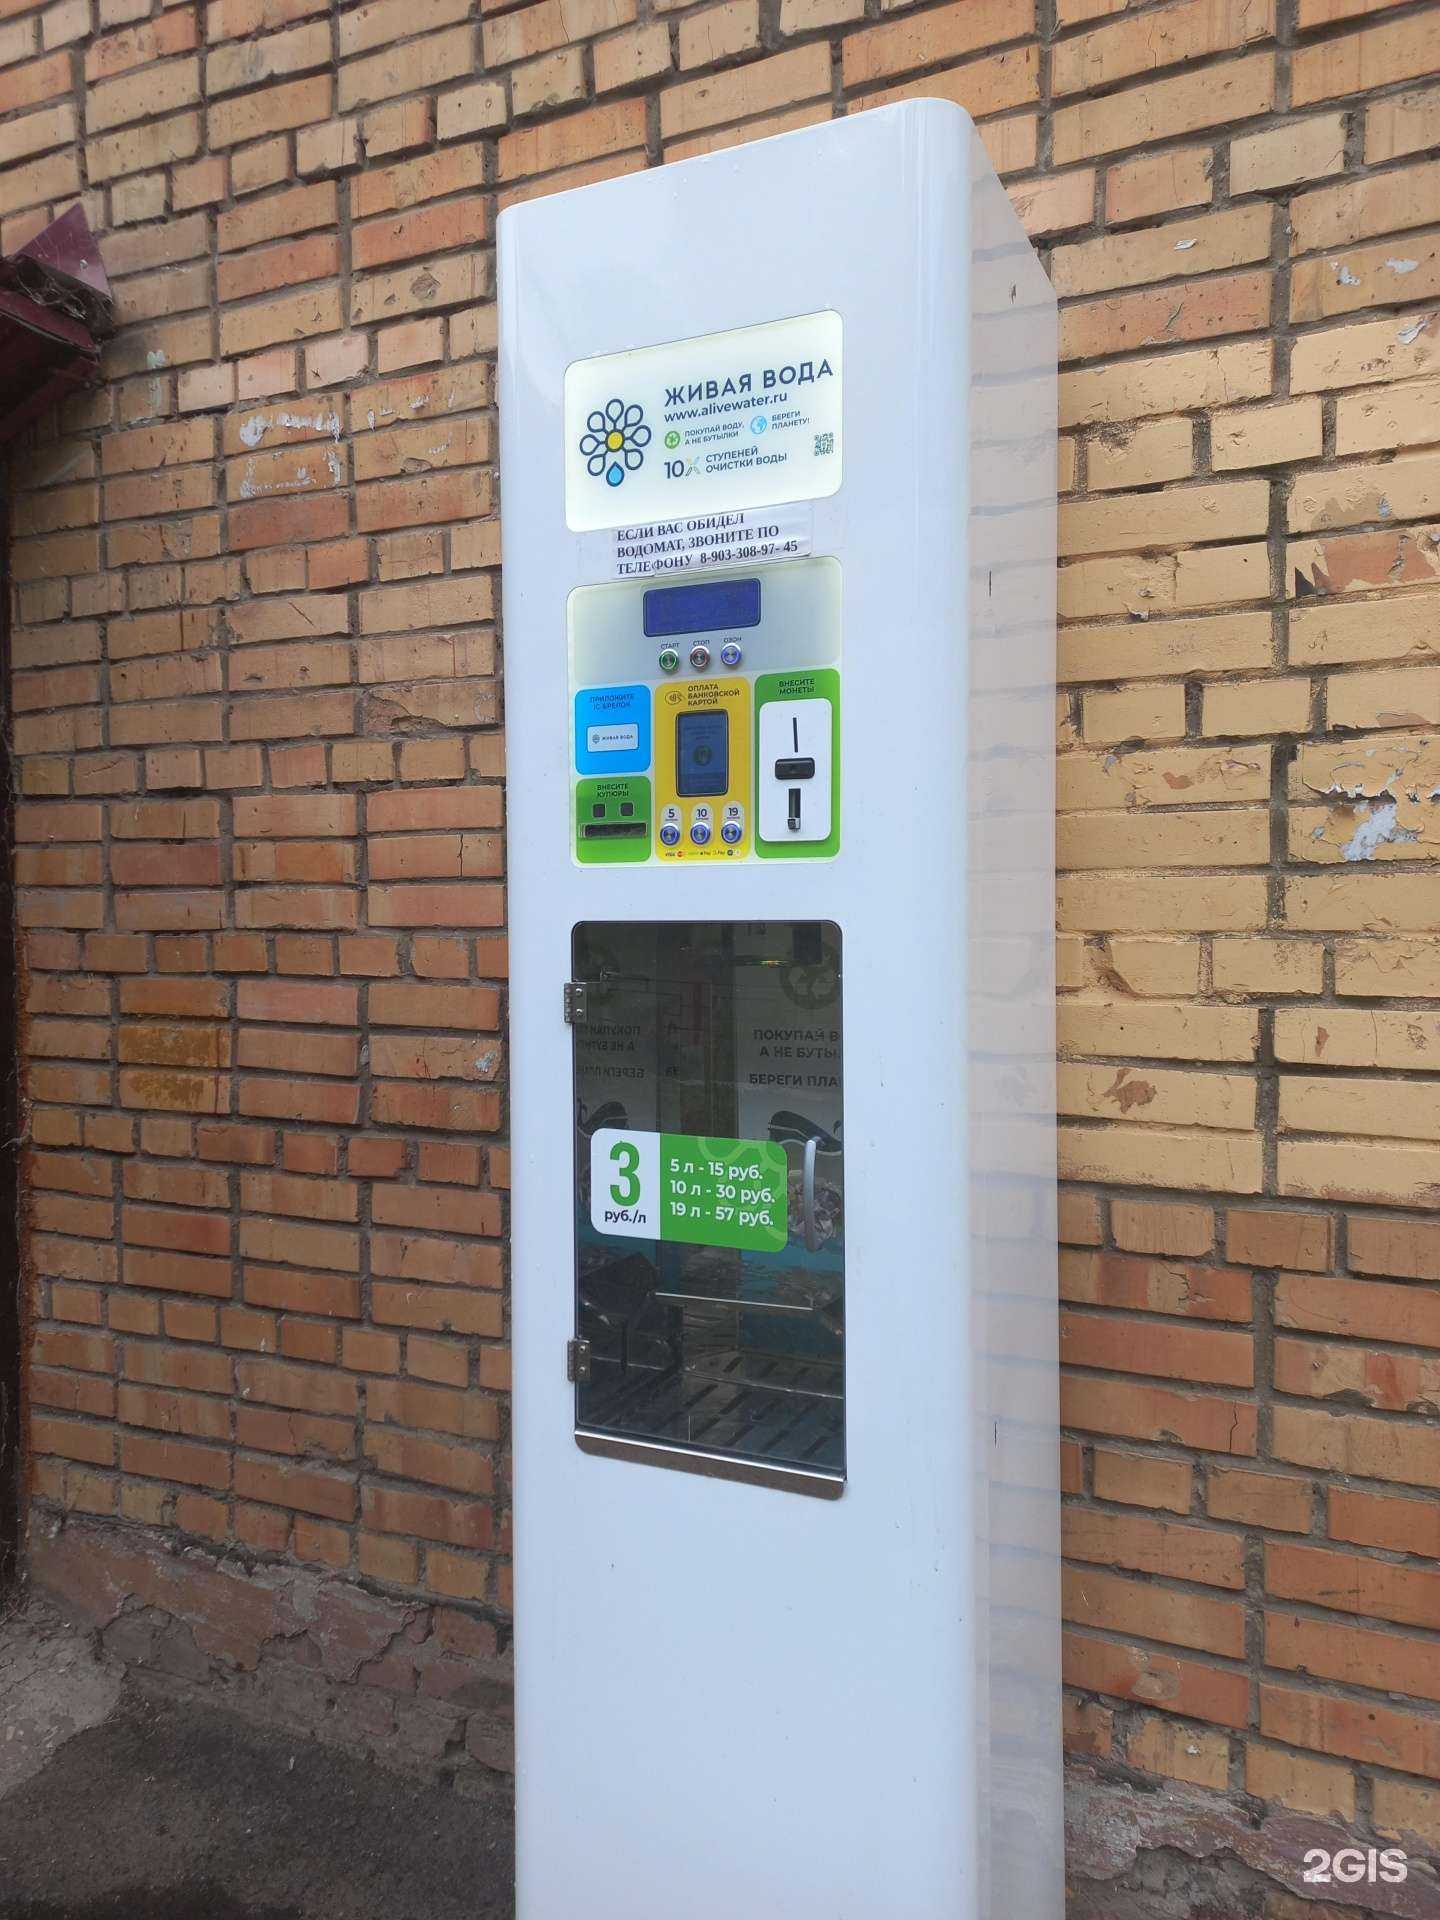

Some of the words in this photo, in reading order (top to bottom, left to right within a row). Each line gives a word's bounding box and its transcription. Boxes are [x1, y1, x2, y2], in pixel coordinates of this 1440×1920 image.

[664, 373, 752, 407] ЖИВАЯ
[763, 359, 833, 388] ВОДА
[664, 392, 787, 423] www.alivewater.ru
[772, 411, 800, 422] БЕРЕГИ
[684, 424, 720, 436] ПОКУПАЙ
[722, 421, 744, 432] ВОДУ,
[772, 417, 810, 430] ПЛАНЕТУ!
[691, 437, 701, 445] НЕ
[703, 432, 738, 444] БУТЫЛКИ
[706, 446, 758, 463] СТУПЕНЕЙ
[706, 458, 753, 473] ОЧИСТКИ
[756, 453, 787, 467] ВОДЫ
[617, 527, 654, 542] ЕСЛИ
[657, 522, 683, 536] ВАС
[687, 513, 744, 535] ОБИДЕЛ
[617, 539, 685, 558] ВОДОМАТ,
[688, 529, 753, 548] ЗВОНИТЕ
[758, 525, 779, 538] ПО
[617, 554, 693, 575] ТЕЛЕФОНУ
[693, 639, 710, 647] СТОП
[688, 684, 718, 692] ОПЛАТА
[779, 679, 814, 688] ВНЕСИТЕ
[688, 690, 740, 699] БАНКОВСКОЙ
[779, 686, 814, 695] МОНЕТЫ
[688, 697, 717, 706] КАРТОЙ
[597, 783, 628, 791] ВНЕСИТЕ
[597, 789, 628, 798] КУПЮРЫ
[668, 808, 674, 818] 5
[697, 808, 708, 818] 10
[728, 807, 738, 816] 19
[753, 1028, 825, 1041] ПОКУПАЙ
[760, 1047, 769, 1057] А
[773, 1047, 793, 1058] НЕ
[797, 1048, 838, 1058] БУТЫ
[750, 1073, 801, 1086] БЕРЕГИ
[609, 1141, 641, 1206] 3
[670, 1159, 679, 1172] 5
[684, 1163, 693, 1173] л
[708, 1162, 724, 1176] 15
[728, 1164, 763, 1182] руб.
[670, 1180, 686, 1194] 10
[690, 1184, 700, 1195] л
[715, 1186, 736, 1198] 30
[740, 1188, 775, 1205] руб.
[605, 1210, 646, 1224] руб./л
[670, 1202, 686, 1216] 19
[690, 1206, 700, 1218] л
[715, 1208, 734, 1221] 57
[739, 1210, 773, 1228] руб.
